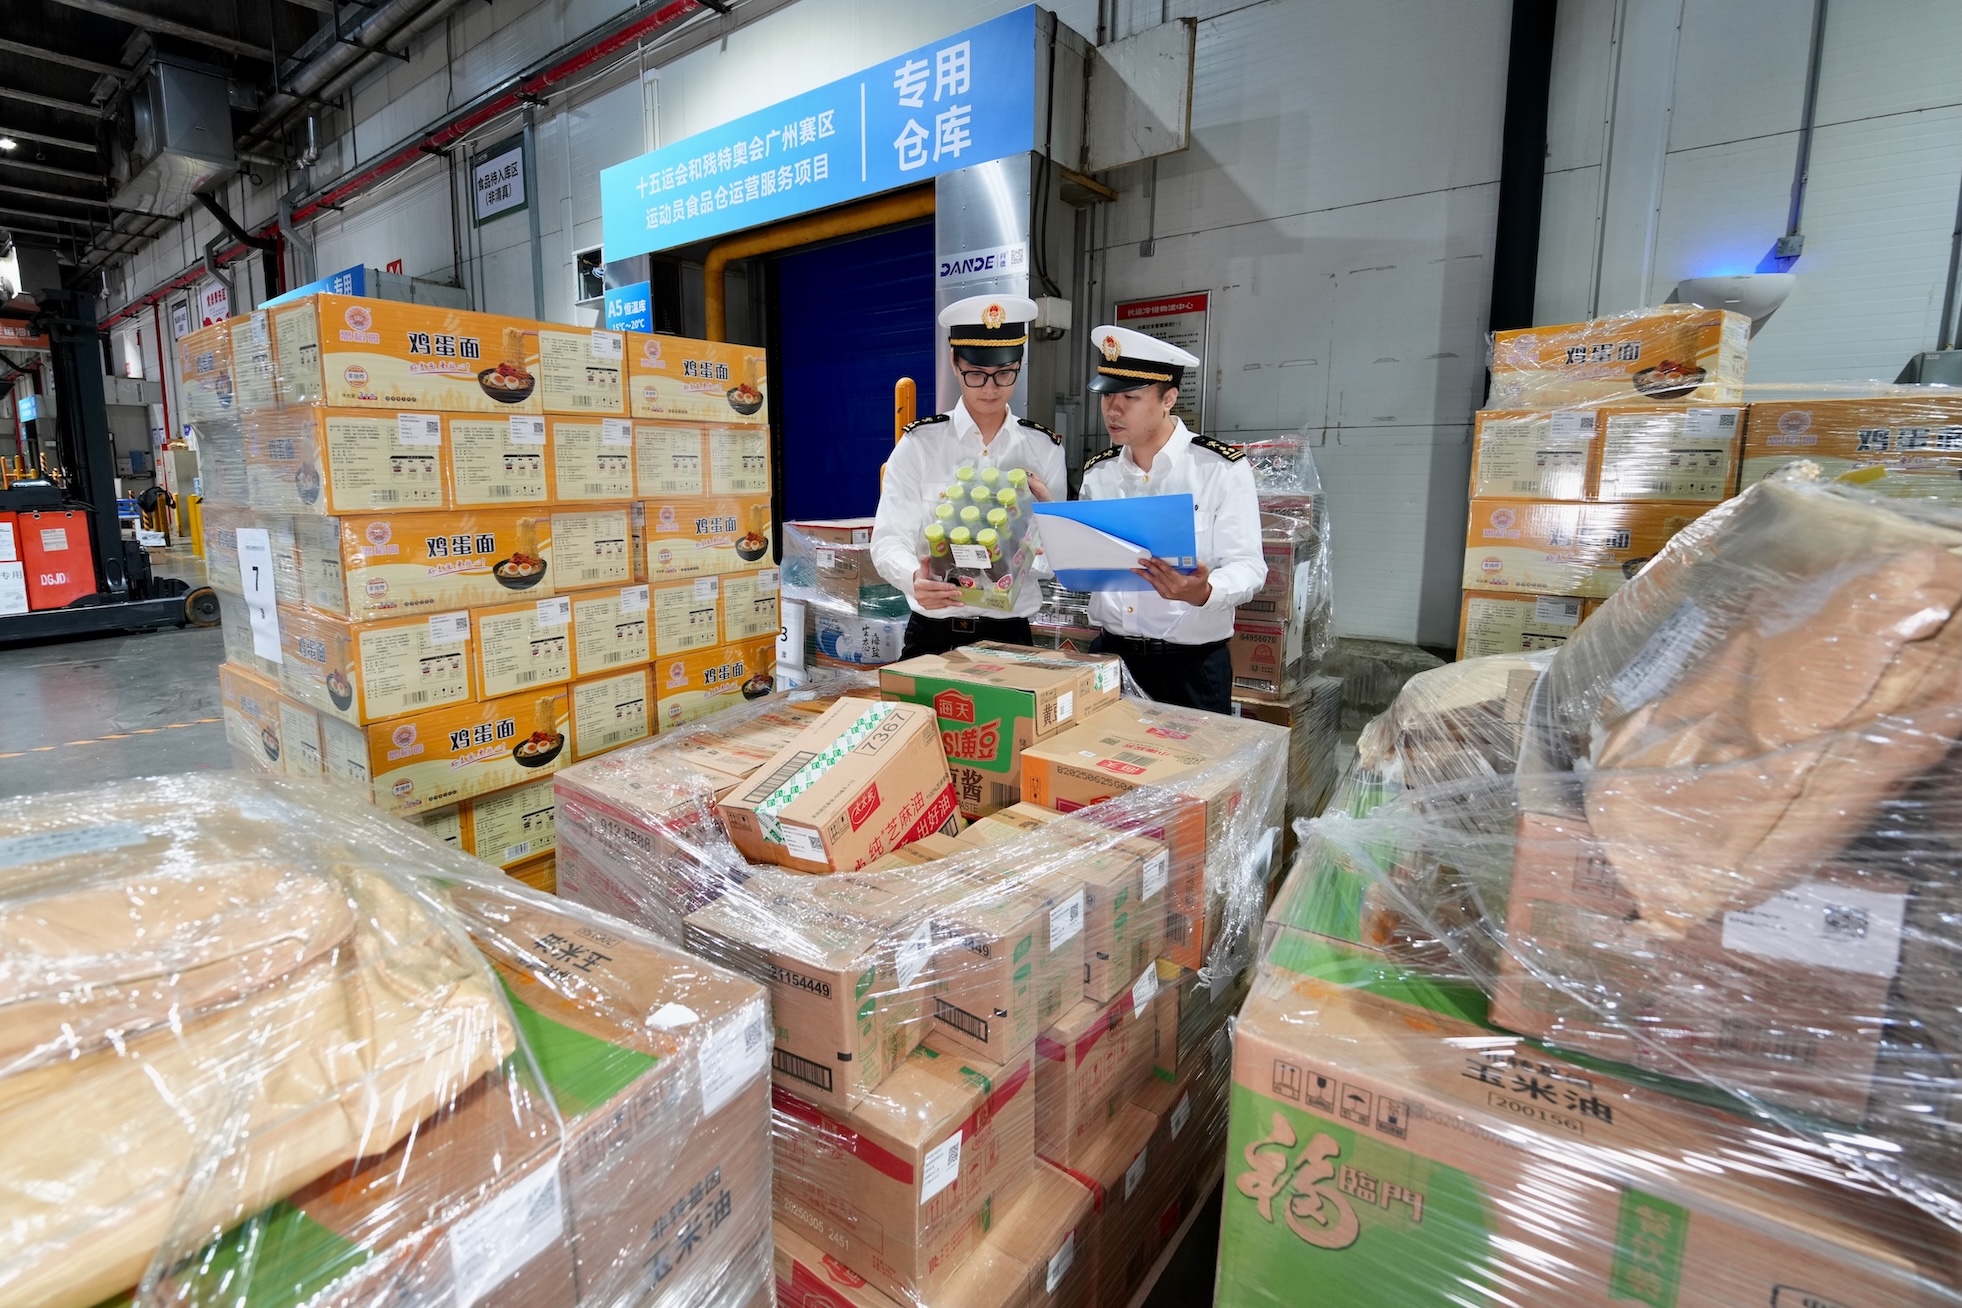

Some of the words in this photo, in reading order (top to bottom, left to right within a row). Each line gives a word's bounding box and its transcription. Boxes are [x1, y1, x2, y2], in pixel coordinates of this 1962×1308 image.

[893, 40, 971, 109] 专用
[893, 105, 972, 172] 仓库
[636, 109, 836, 199] 十五运会和残特奥会广州赛区
[477, 161, 519, 191] 食品待入库区
[645, 154, 830, 231] 运动员食品仓运营服务项目
[940, 255, 995, 278] DANDE
[608, 298, 623, 319] A5
[625, 302, 647, 317] 恒温库
[408, 332, 480, 359] 鸡蛋面
[1564, 341, 1642, 365] 鸡蛋面
[683, 359, 729, 381] 鸡蛋面
[695, 516, 737, 534] 鸡蛋面
[425, 533, 495, 558] 鸡蛋面
[252, 566, 259, 592] 7
[781, 626, 788, 642] 3
[1240, 633, 1276, 643] 64956070
[703, 662, 744, 685] 鸡蛋面
[939, 699, 969, 720] 海天
[449, 717, 515, 752] 鸡蛋面
[861, 712, 906, 752] 7367
[1104, 760, 1140, 775] 海天
[533, 933, 613, 972] 玉米油
[1461, 1057, 1614, 1125] 玉米油
[1497, 1095, 1579, 1131] 200156
[643, 1189, 732, 1295] 玉米油
[828, 1228, 849, 1251] 2451
